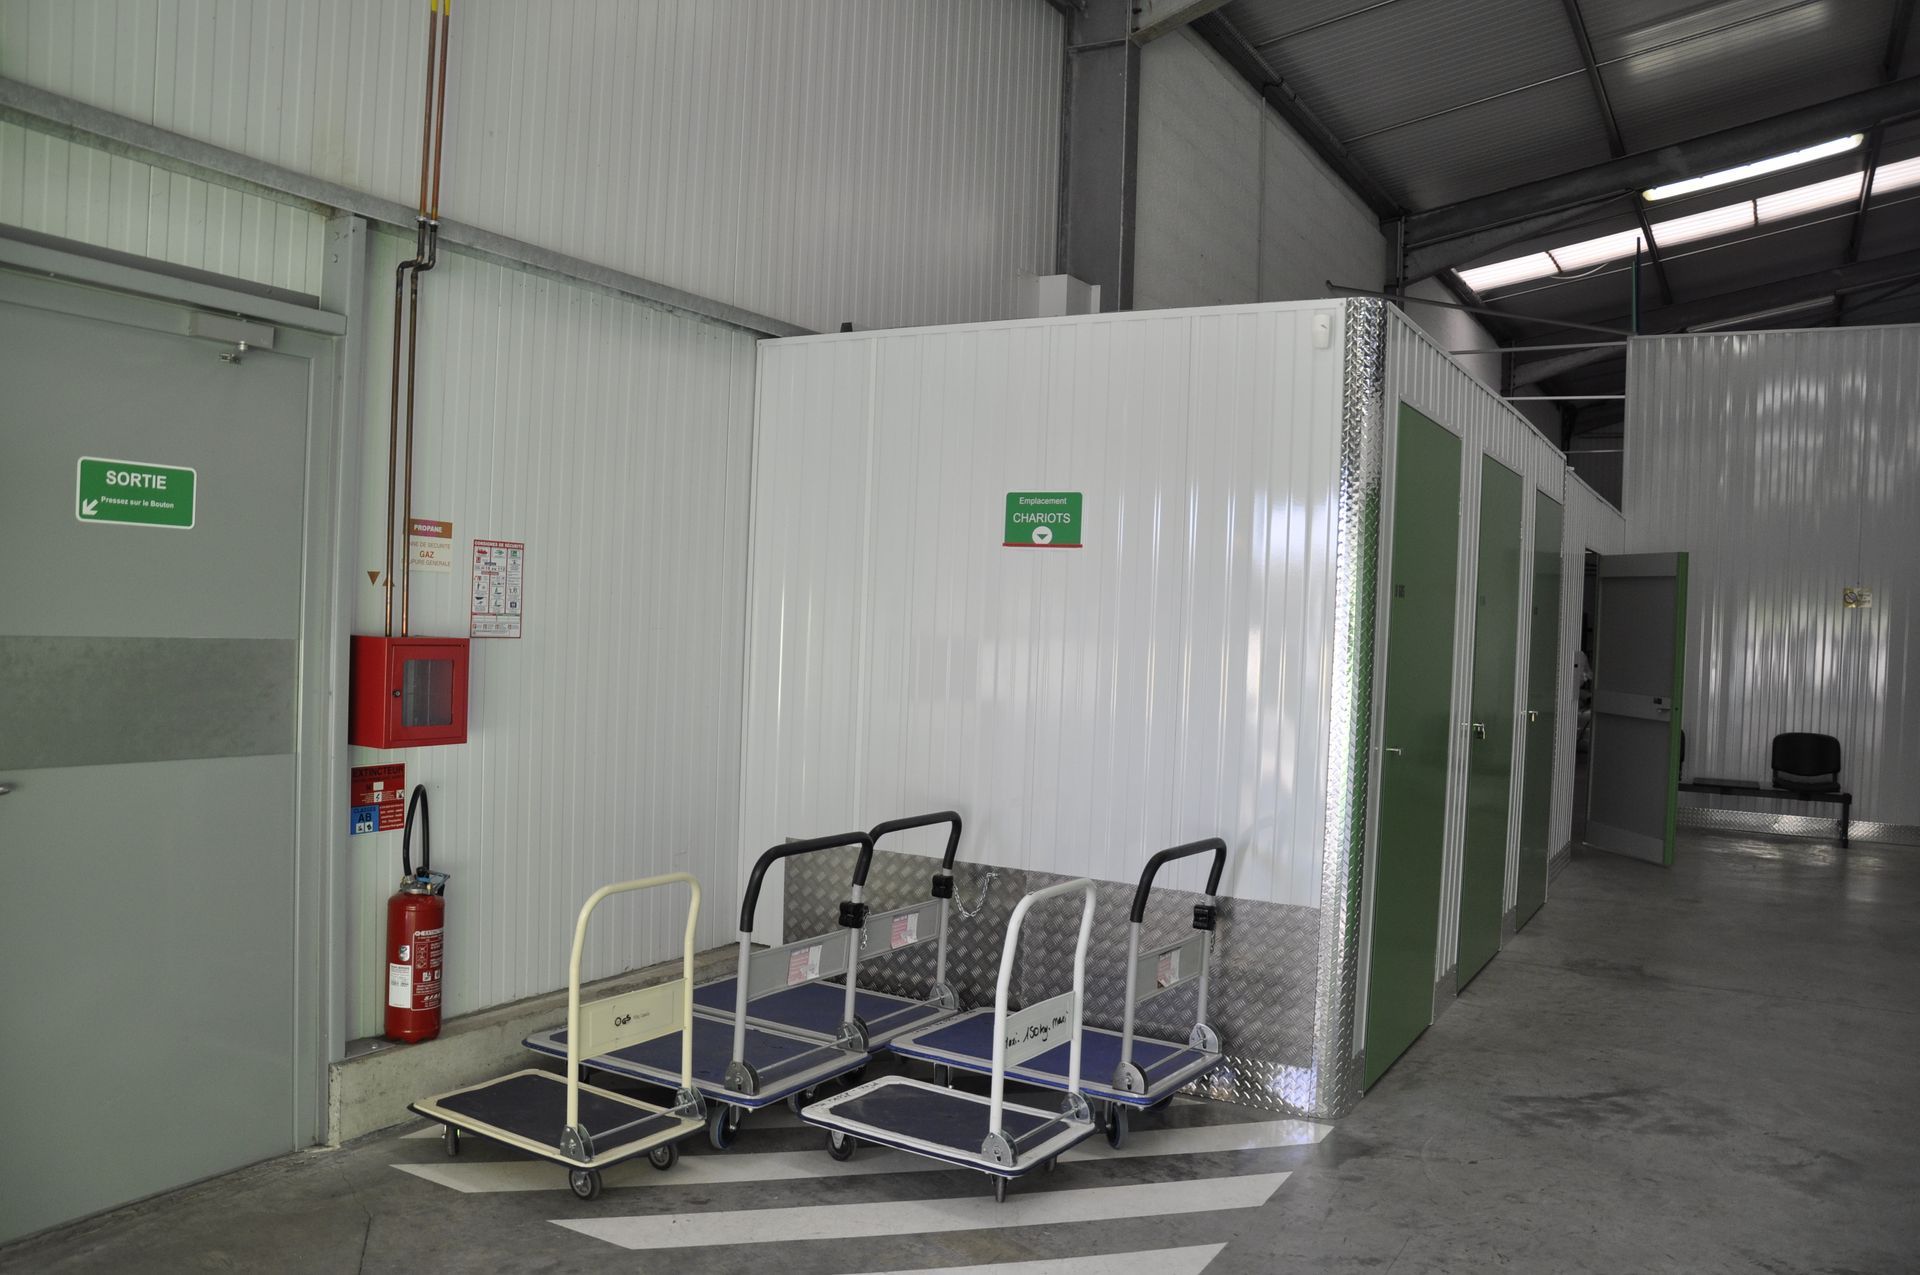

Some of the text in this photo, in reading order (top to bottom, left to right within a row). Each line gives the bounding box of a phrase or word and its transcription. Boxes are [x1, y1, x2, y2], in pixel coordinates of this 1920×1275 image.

[106, 470, 167, 490] SORTIE
[101, 496, 128, 505] Pressez
[142, 498, 149, 507] le
[150, 499, 174, 508] Bouton
[1019, 496, 1067, 506] Emplacement
[1013, 512, 1071, 524] CHARIOTS
[413, 524, 443, 533] PROPANE
[420, 550, 434, 558] GAZ
